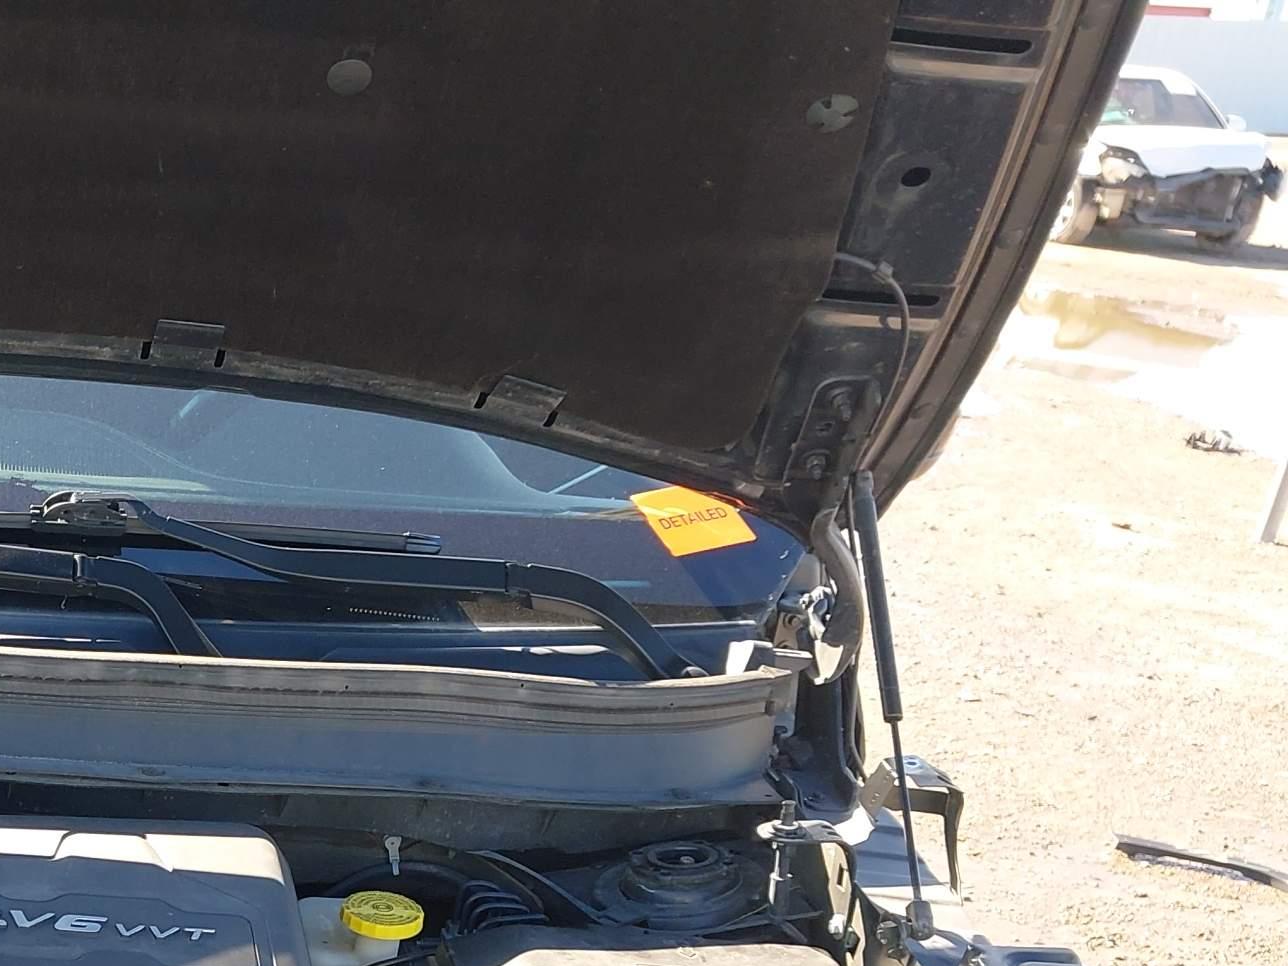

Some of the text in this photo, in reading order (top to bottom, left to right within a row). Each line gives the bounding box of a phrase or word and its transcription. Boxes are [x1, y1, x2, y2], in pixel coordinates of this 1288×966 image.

[658, 506, 728, 530] DETAILED
[9, 909, 216, 942] V6 VVT
